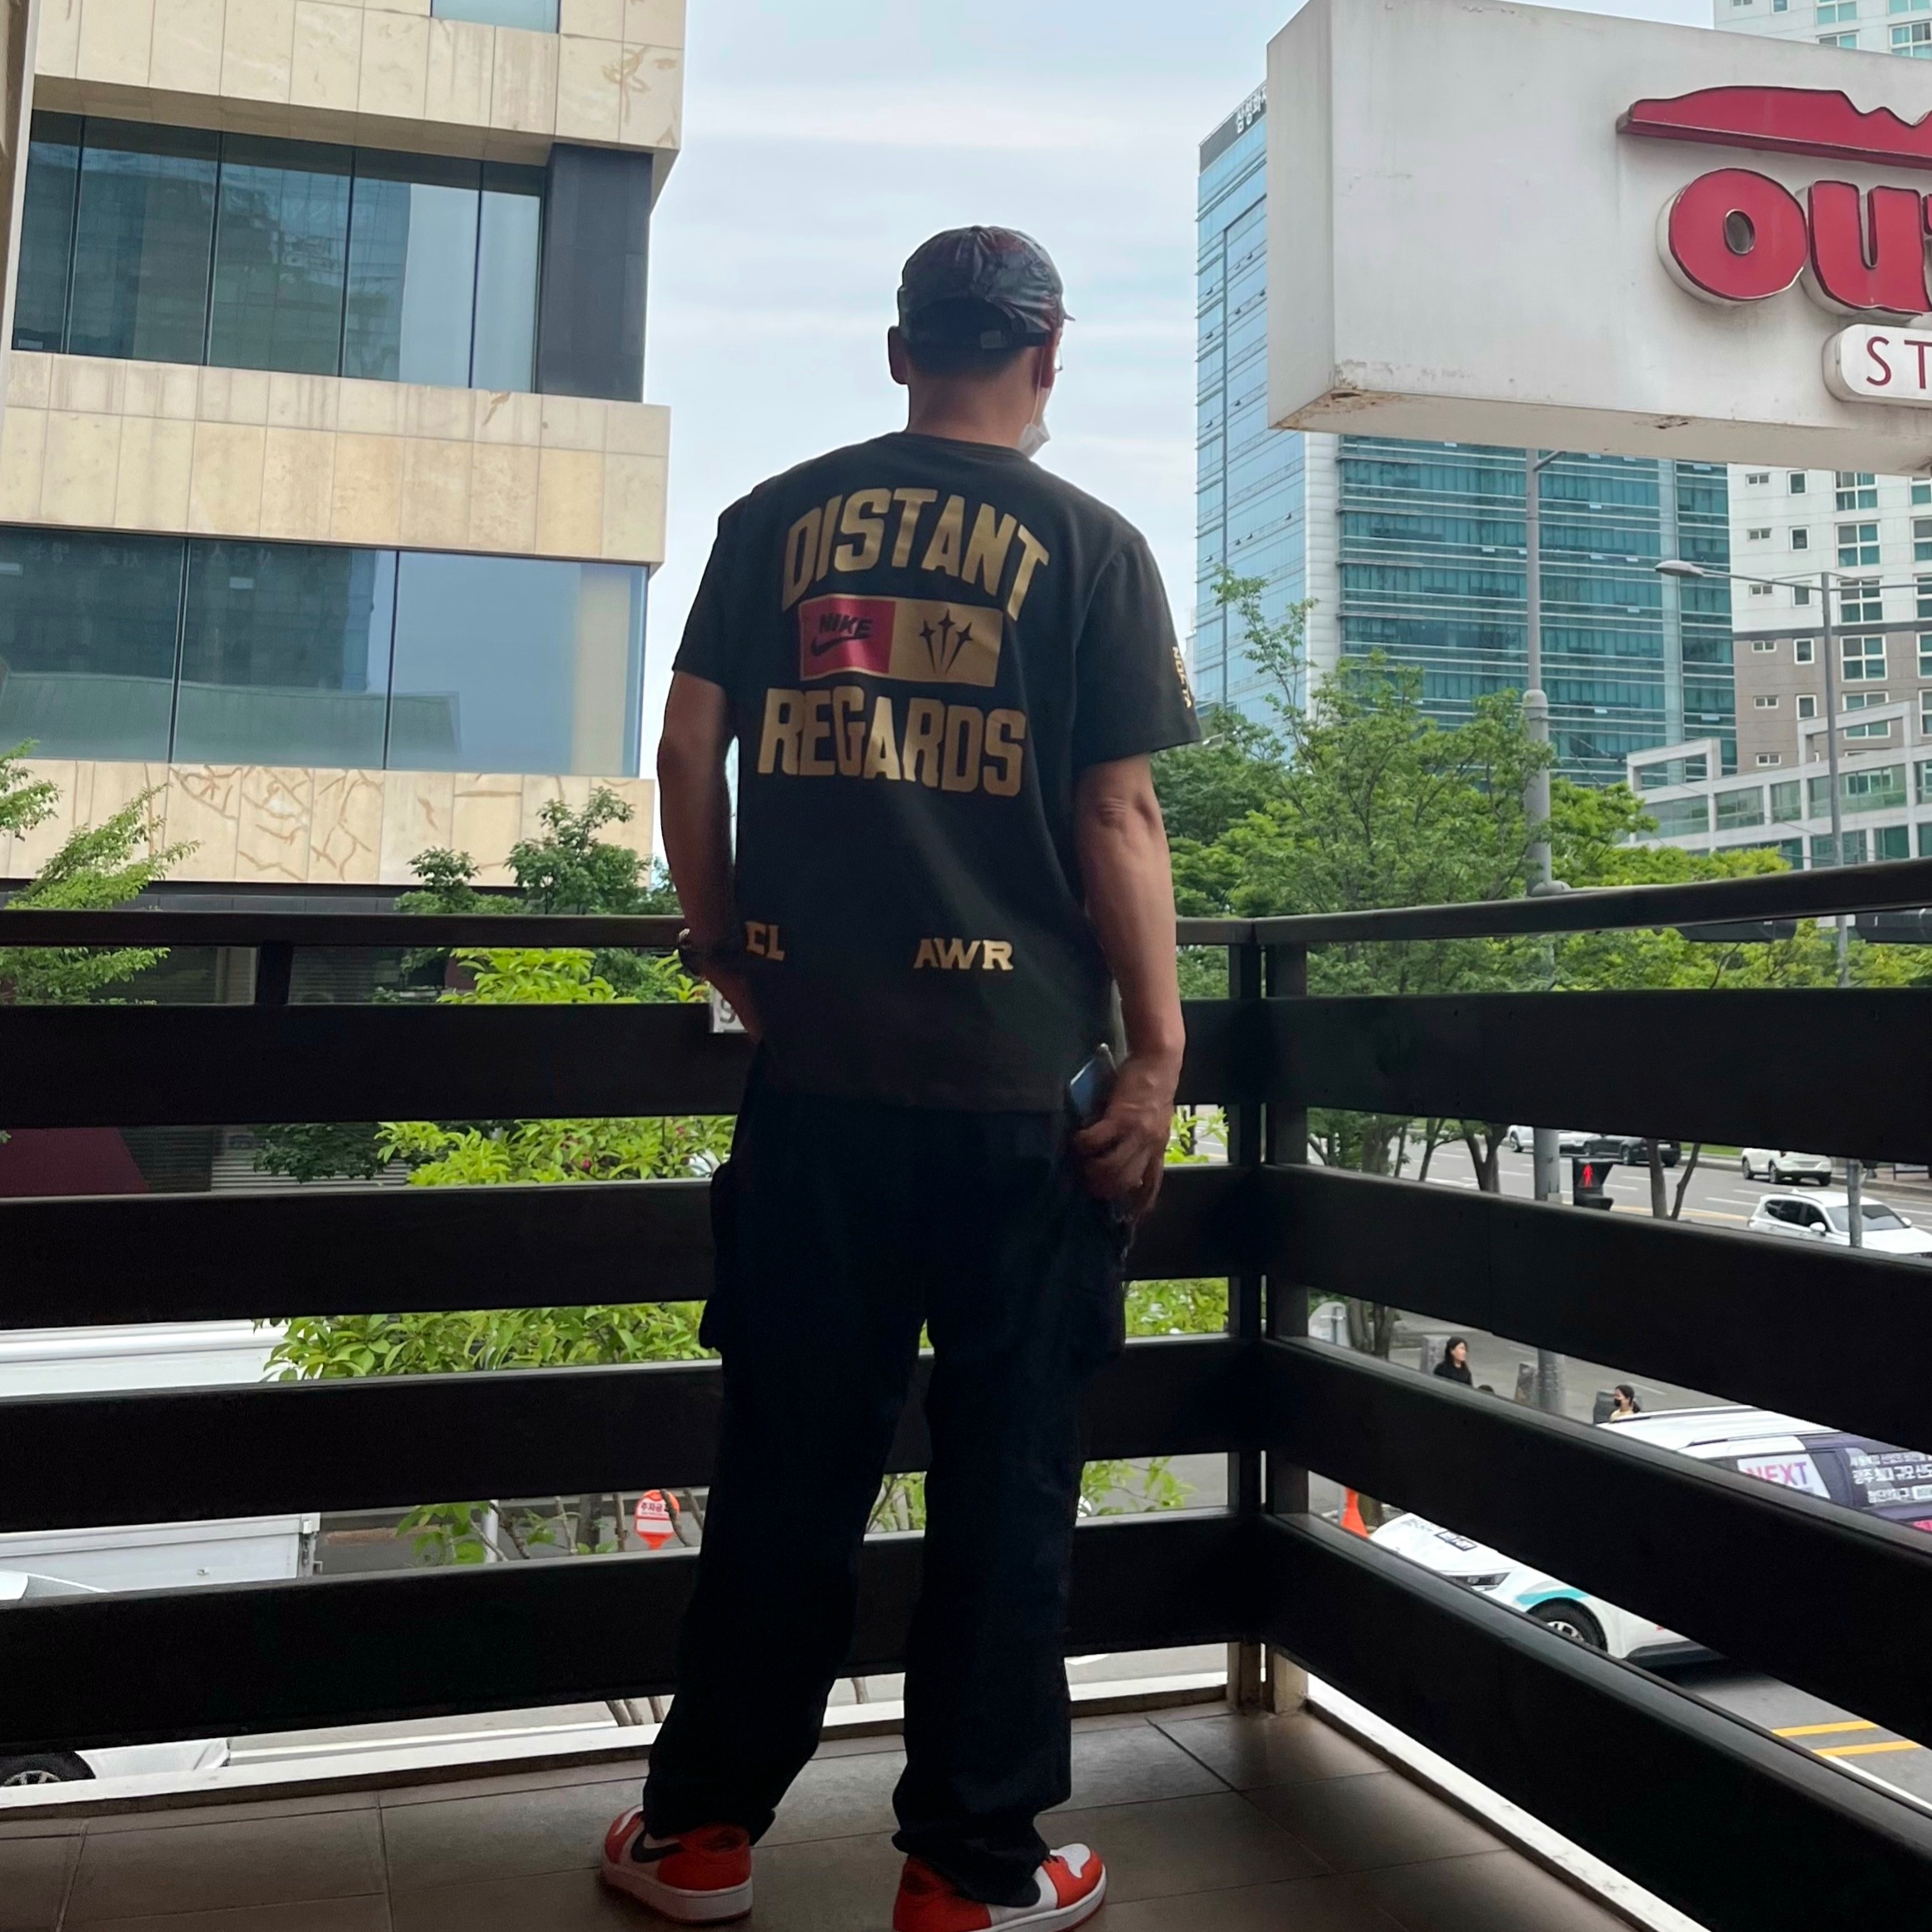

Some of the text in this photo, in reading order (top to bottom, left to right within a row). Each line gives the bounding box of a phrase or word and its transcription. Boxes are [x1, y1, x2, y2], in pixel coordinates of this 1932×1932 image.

[782, 488, 1049, 621] DISTANT
[819, 612, 873, 639] NIKE
[758, 685, 1026, 797] REGARDS
[914, 939, 1013, 970] AWR
